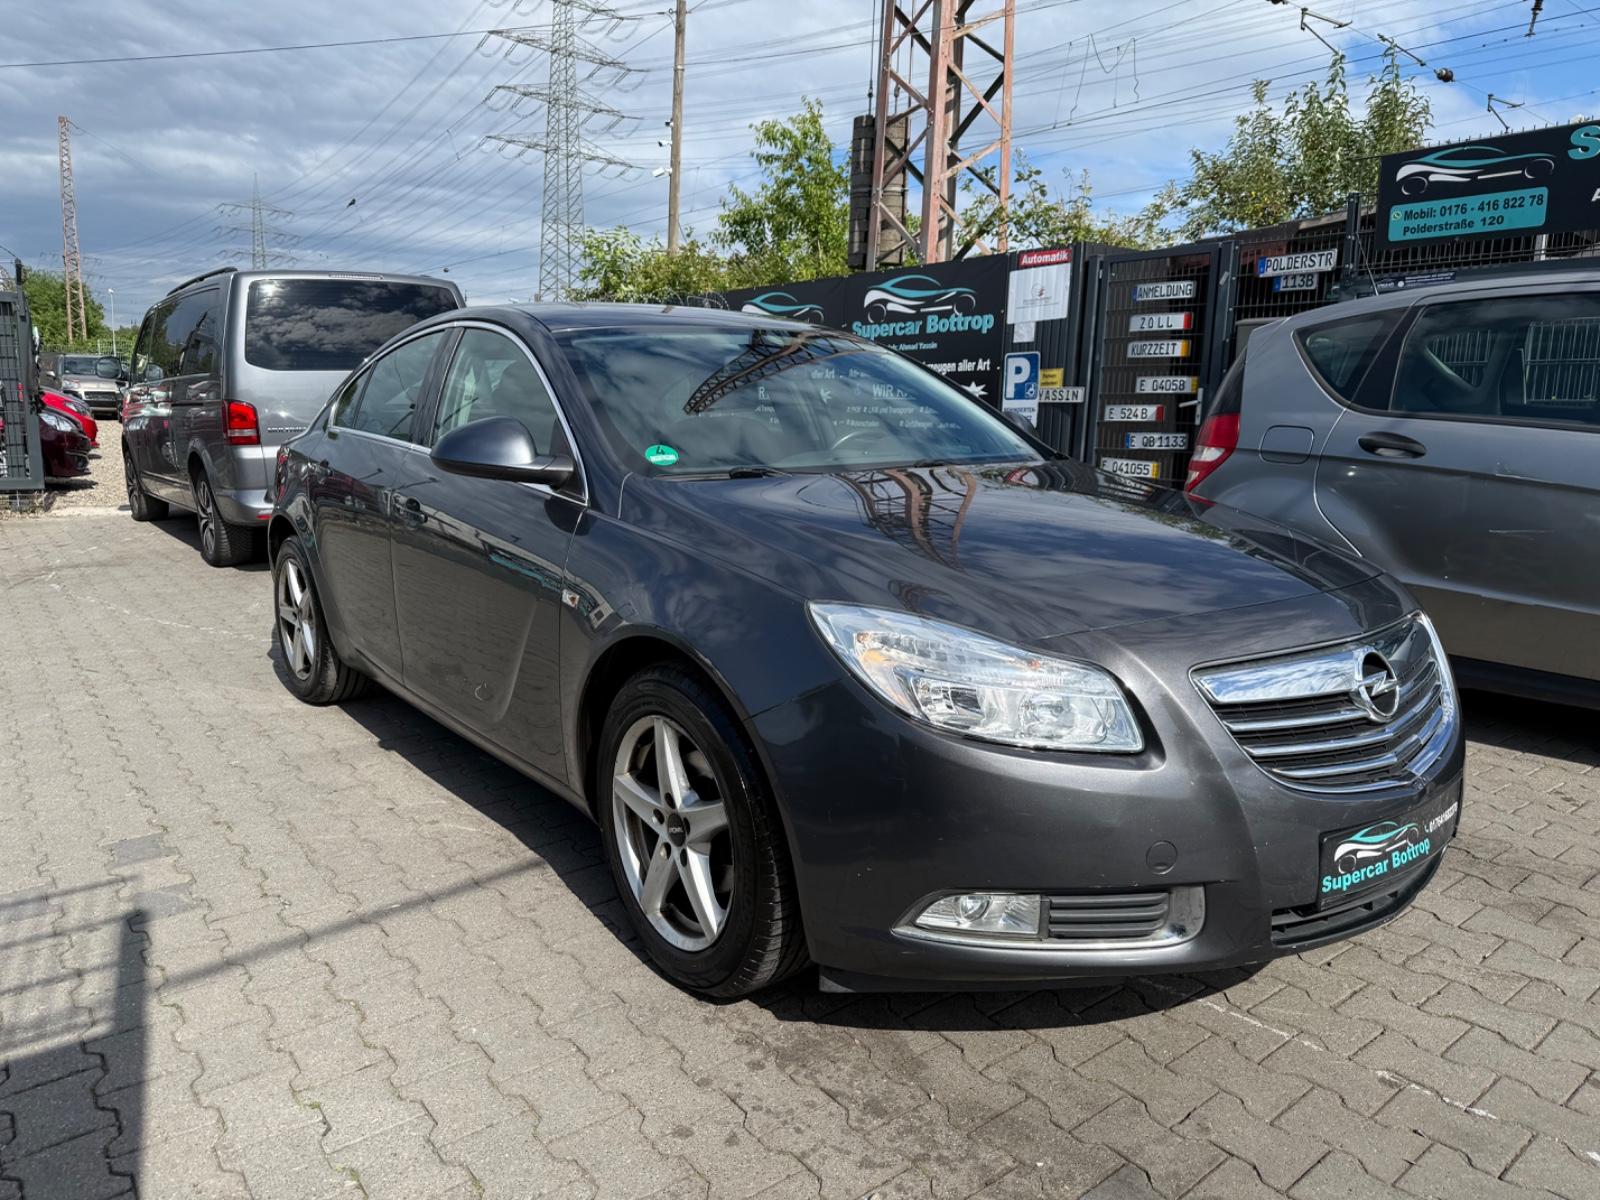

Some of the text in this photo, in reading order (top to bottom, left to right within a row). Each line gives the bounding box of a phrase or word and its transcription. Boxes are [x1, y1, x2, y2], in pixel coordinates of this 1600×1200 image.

[1404, 207, 1436, 221] Mobil:
[1440, 200, 1467, 217] 0176
[1478, 199, 1499, 213] 416
[1503, 196, 1525, 210] 822
[1529, 194, 1544, 207] 78
[1402, 215, 1504, 236] Polderstraße 120
[1022, 252, 1068, 266] Automatik
[1266, 252, 1333, 272] POLDERSTR
[1282, 274, 1314, 288] 113B
[1136, 282, 1193, 300] ANMELDUNG
[852, 313, 994, 340] Supercar Bottrop
[1140, 317, 1173, 329] ZOLL
[1131, 343, 1177, 355] KURZZEIT
[958, 359, 975, 372] aller
[976, 357, 991, 371] Art
[1006, 357, 1030, 398] P
[1152, 380, 1185, 391] 04058
[1112, 462, 1150, 475] 041055
[1322, 837, 1430, 893] Supercar Bottrop
